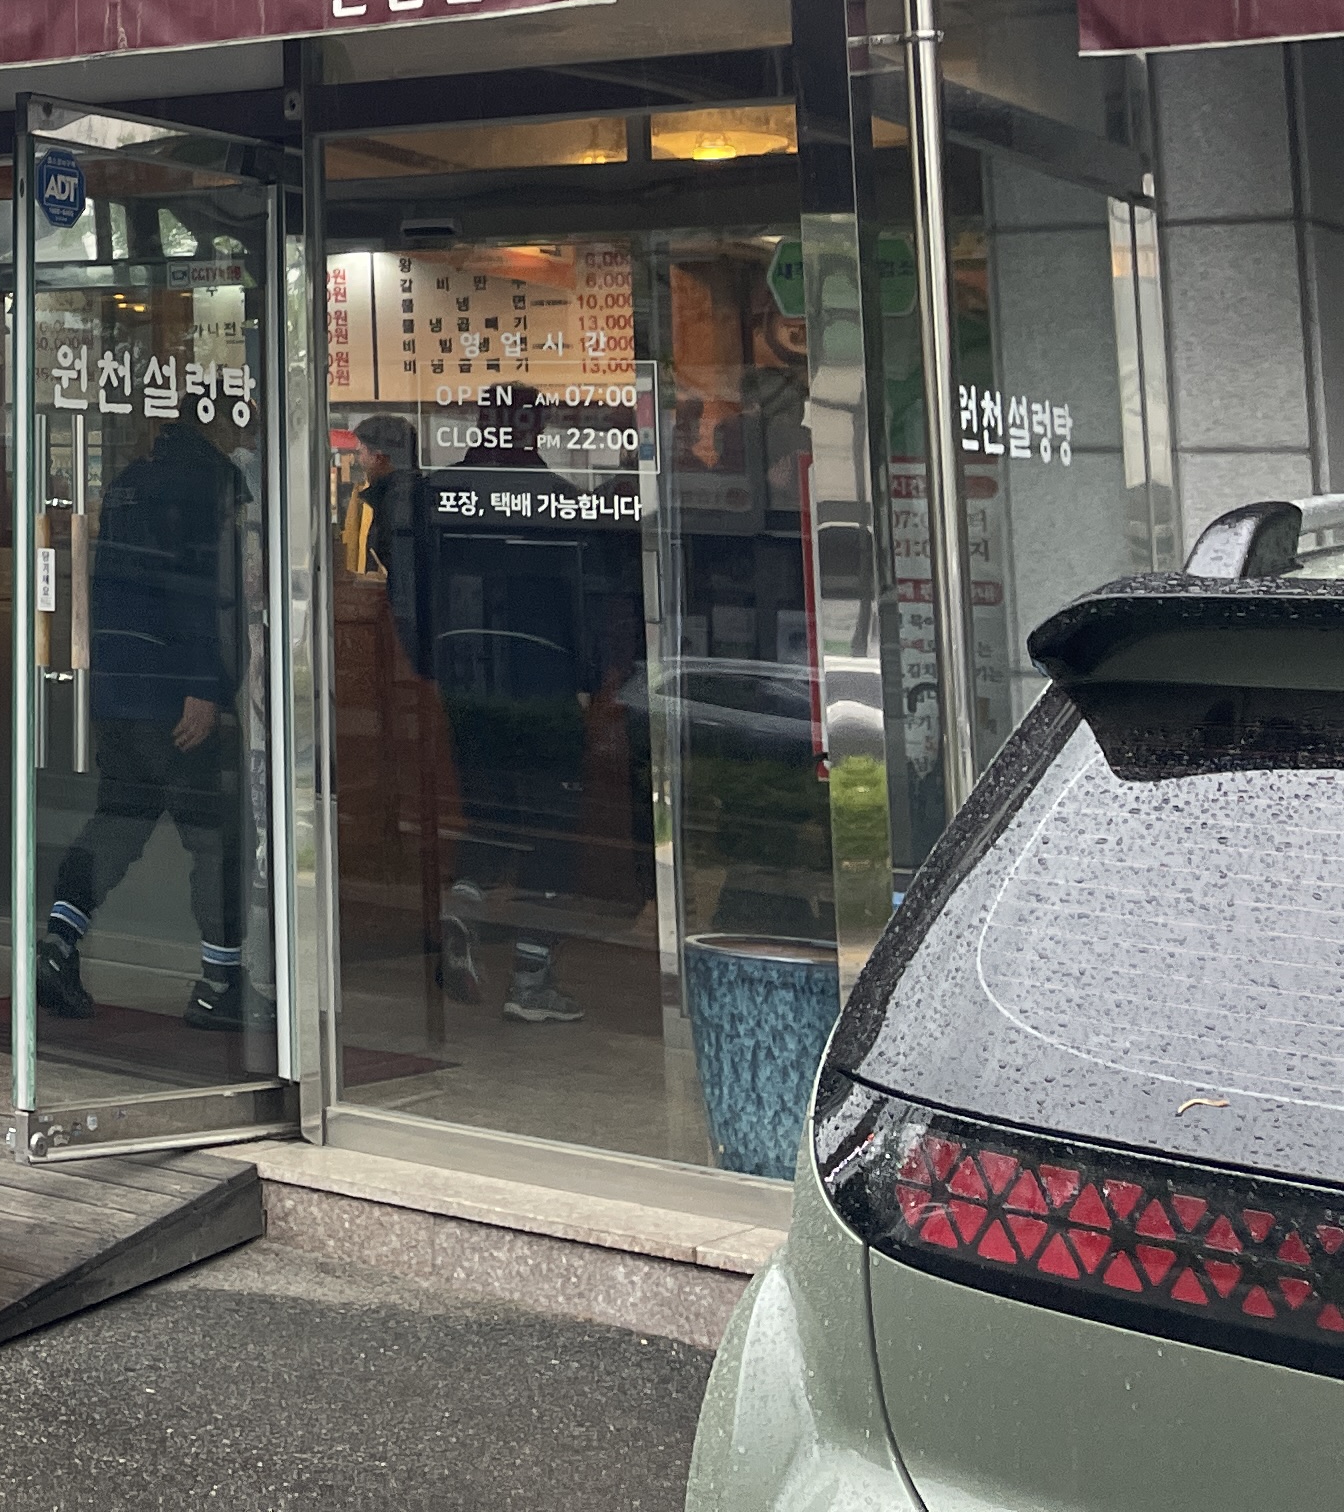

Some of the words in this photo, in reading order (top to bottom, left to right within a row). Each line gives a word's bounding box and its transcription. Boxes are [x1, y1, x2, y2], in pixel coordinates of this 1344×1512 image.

[44, 173, 79, 203] ADT
[51, 345, 256, 428] 원천설렁탕
[436, 386, 513, 407] OPEN
[565, 385, 637, 408] 07:00
[436, 426, 513, 449] CLOSE
[567, 428, 639, 450] 22:00
[959, 385, 1072, 466] 원천설렁탕
[438, 491, 485, 517] 포장,
[490, 492, 532, 517] 택배
[537, 492, 642, 521] 가능합니다
